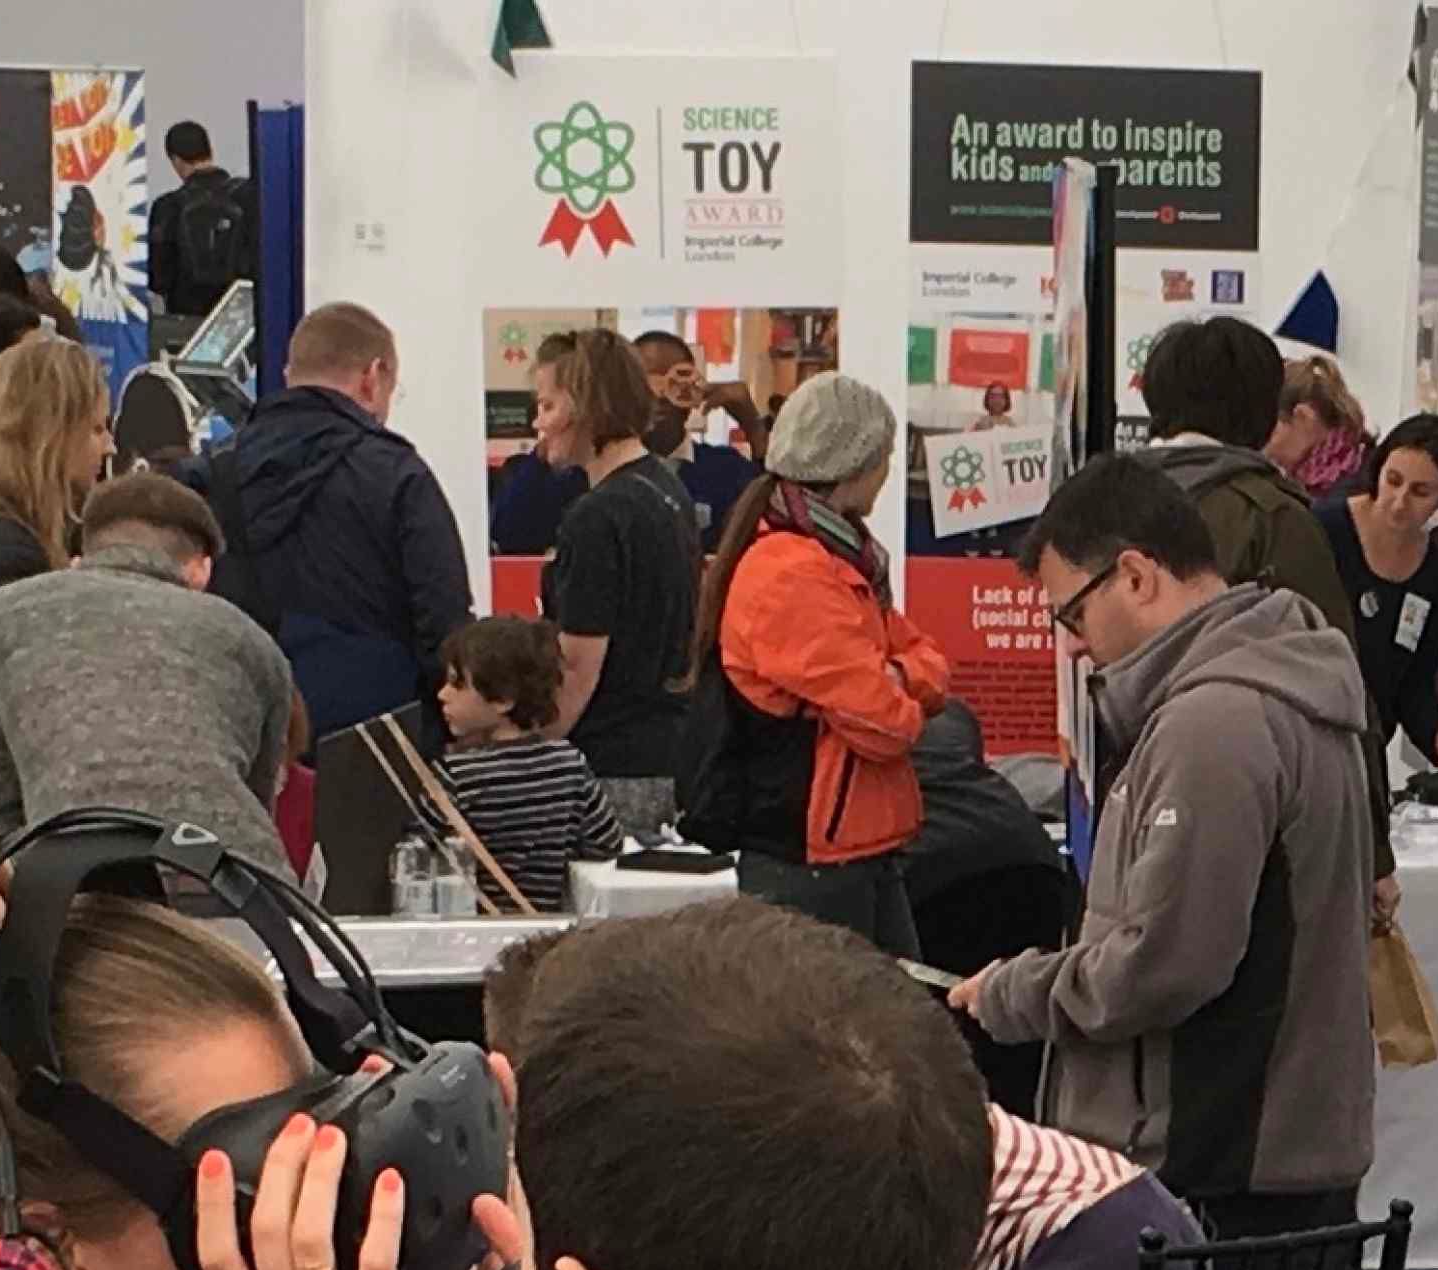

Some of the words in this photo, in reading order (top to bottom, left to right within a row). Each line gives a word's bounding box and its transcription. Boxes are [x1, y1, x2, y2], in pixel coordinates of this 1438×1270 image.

[682, 106, 779, 131] SCIENCE
[950, 113, 990, 149] An
[995, 117, 1085, 150] award
[1090, 121, 1118, 151] to
[1125, 119, 1223, 159] inspire
[682, 140, 782, 194] TOY
[950, 146, 1015, 182] kids
[687, 204, 785, 223] AWARD
[685, 235, 736, 250] Imperial
[738, 235, 784, 251] College
[1002, 454, 1048, 485] TOY
[972, 585, 1013, 605] Lack
[1017, 585, 1034, 606] of
[972, 606, 1029, 630] (social
[986, 632, 1011, 649] we
[1015, 632, 1043, 650] are
